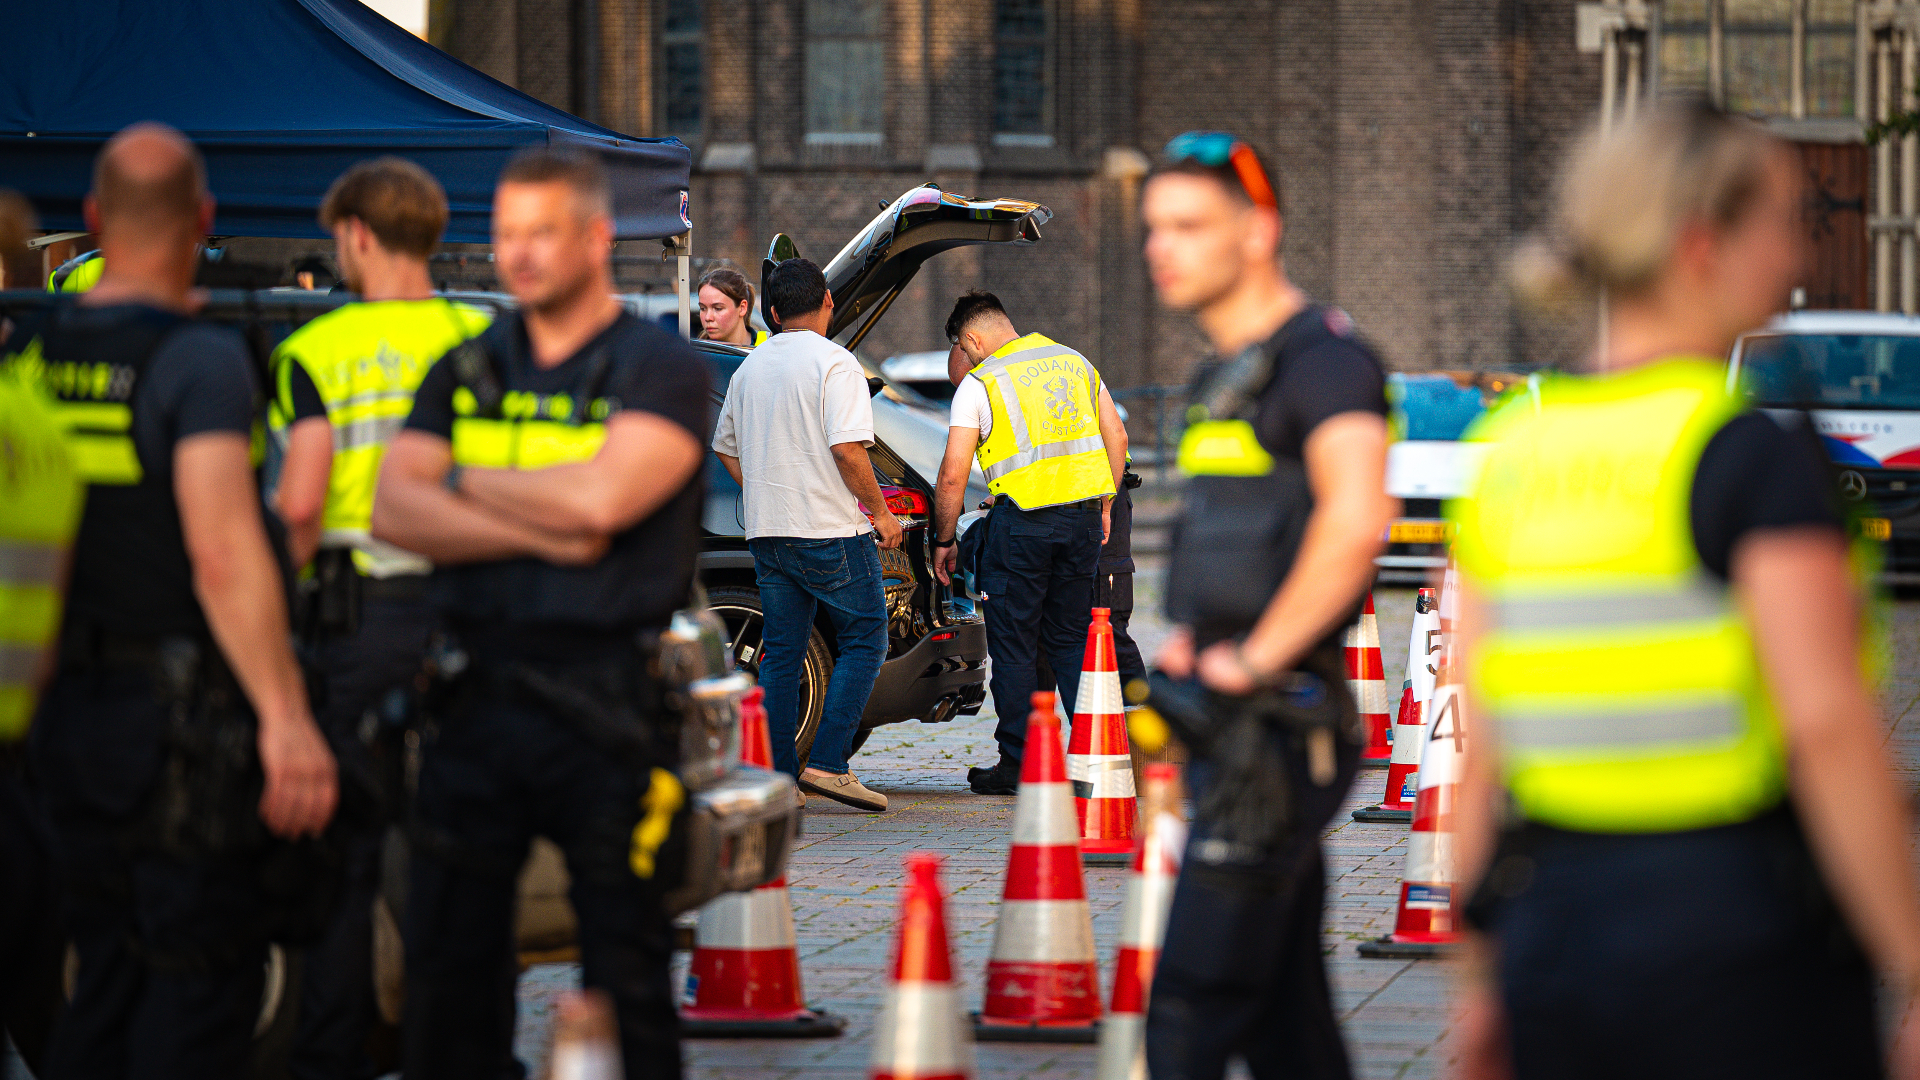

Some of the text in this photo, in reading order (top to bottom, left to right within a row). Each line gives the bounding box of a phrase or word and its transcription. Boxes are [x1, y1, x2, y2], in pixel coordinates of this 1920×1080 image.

[1018, 359, 1086, 388] DOUANE
[1042, 414, 1093, 436] CUSTOMS
[1429, 692, 1467, 753] 4
